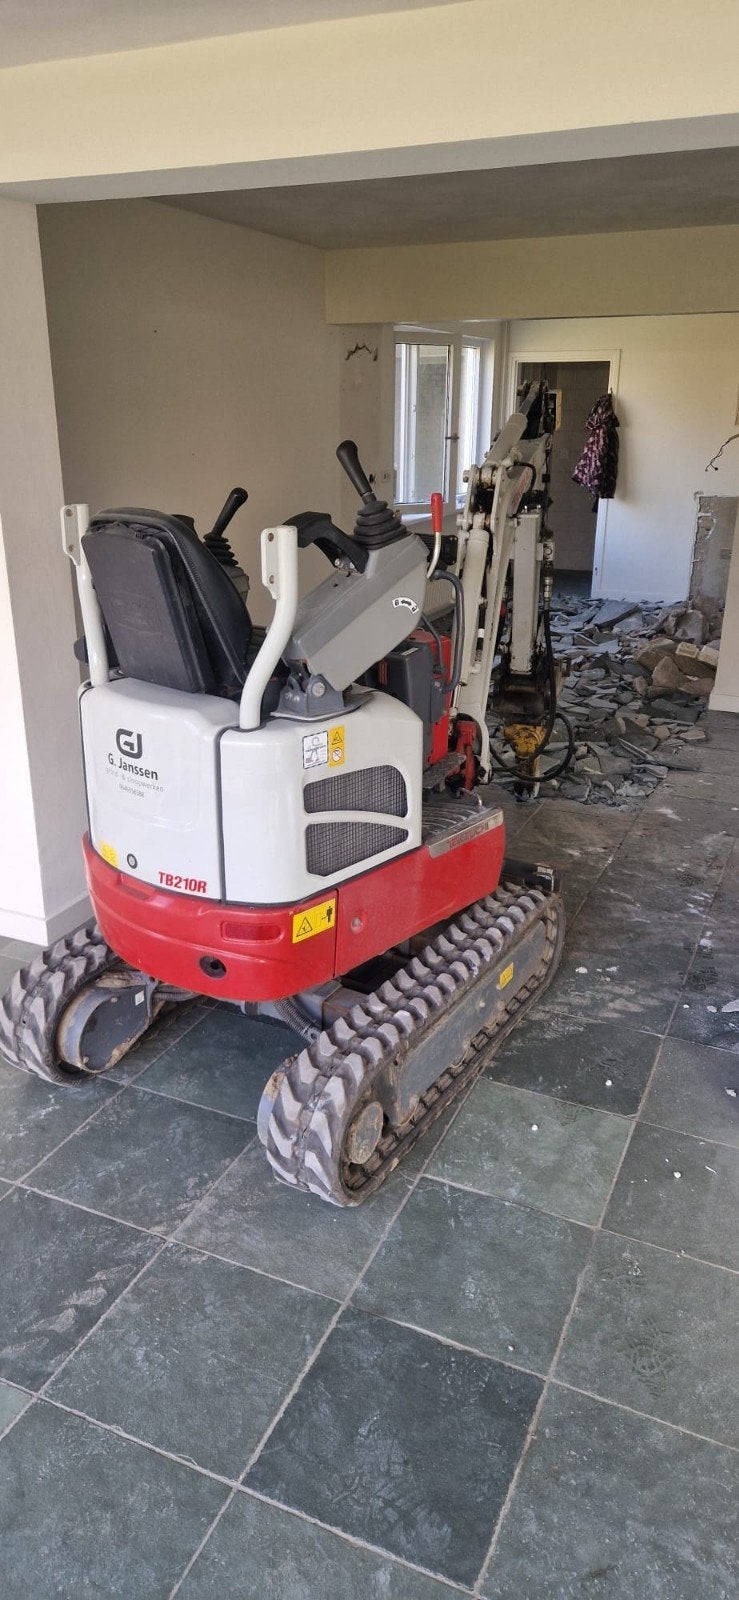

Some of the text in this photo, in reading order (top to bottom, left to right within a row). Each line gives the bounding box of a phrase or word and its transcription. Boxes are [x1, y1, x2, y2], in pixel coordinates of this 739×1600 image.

[108, 752, 159, 781] G. Janssen
[158, 871, 207, 894] TB210R
